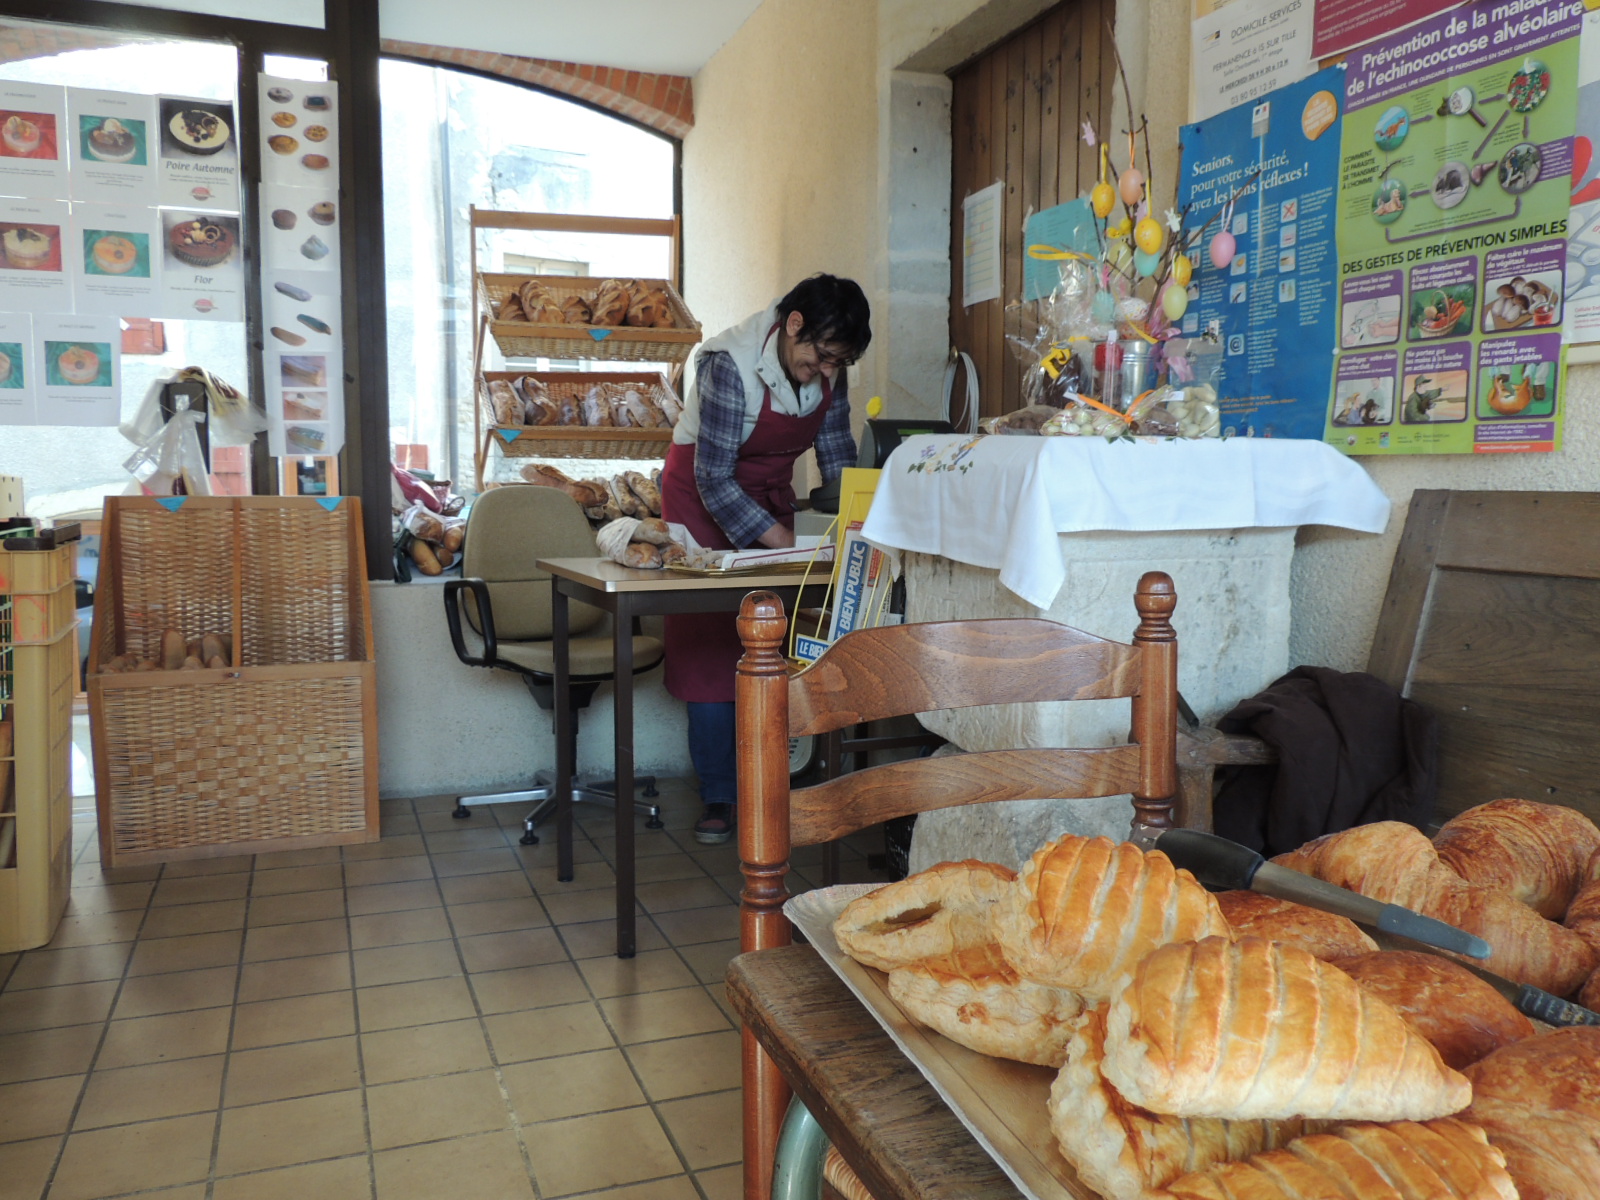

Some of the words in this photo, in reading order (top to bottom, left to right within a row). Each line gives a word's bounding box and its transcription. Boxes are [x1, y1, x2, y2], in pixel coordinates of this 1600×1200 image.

[1231, 16, 1266, 39] DOMICILE
[1270, 0, 1302, 22] SERVICES
[1362, 29, 1441, 72] Prévention
[1444, 16, 1468, 39] de
[1472, 10, 1488, 30] la
[1492, 0, 1552, 22] malad
[1212, 48, 1250, 72] PERMANENCE
[1266, 37, 1280, 48] SUR
[1282, 30, 1296, 42] TILLE
[1346, 78, 1364, 97] de
[1368, 36, 1488, 90] l'echinococcose
[1493, 1, 1582, 44] alvéolaire
[1455, 54, 1488, 70] PERSONNES
[1488, 52, 1496, 60] EN
[1498, 46, 1512, 56] SONT
[1514, 34, 1550, 52] GRAVEMENT
[1550, 23, 1581, 38] ATTEINTES
[1344, 149, 1373, 164] COMMENT
[1350, 157, 1376, 169] PARASITE
[165, 160, 191, 172] Poire
[192, 162, 235, 174] Automne
[1192, 154, 1234, 177] Seniors,
[1343, 174, 1349, 182] SE
[1350, 165, 1380, 176] TRANSMET
[1190, 179, 1216, 200] pour
[1218, 168, 1242, 185] votre
[1244, 149, 1290, 174] sécurité,
[1190, 198, 1212, 216] ayez
[1214, 190, 1228, 207] les
[1230, 182, 1257, 202] bons
[1260, 168, 1302, 190] réflexes
[1342, 262, 1363, 274] DES
[1365, 252, 1404, 270] GESTES
[1407, 248, 1423, 262] DE
[1425, 232, 1506, 258] PRÉVENTION
[1509, 219, 1567, 242] SIMPLES
[1486, 252, 1506, 261] Faites
[1506, 250, 1522, 258] cuire
[1530, 243, 1563, 254] maximum
[1430, 260, 1470, 272] abondamment
[1486, 261, 1496, 269] de
[194, 275, 214, 284] Flor
[1482, 340, 1516, 349] Manipulez
[1491, 347, 1518, 356] renards
[1416, 350, 1435, 358] portez
[1493, 356, 1513, 365] gants
[1513, 353, 1542, 363] jetables
[846, 544, 866, 596] PUBLIC
[840, 595, 856, 631] BIEN
[799, 640, 810, 655] LE
